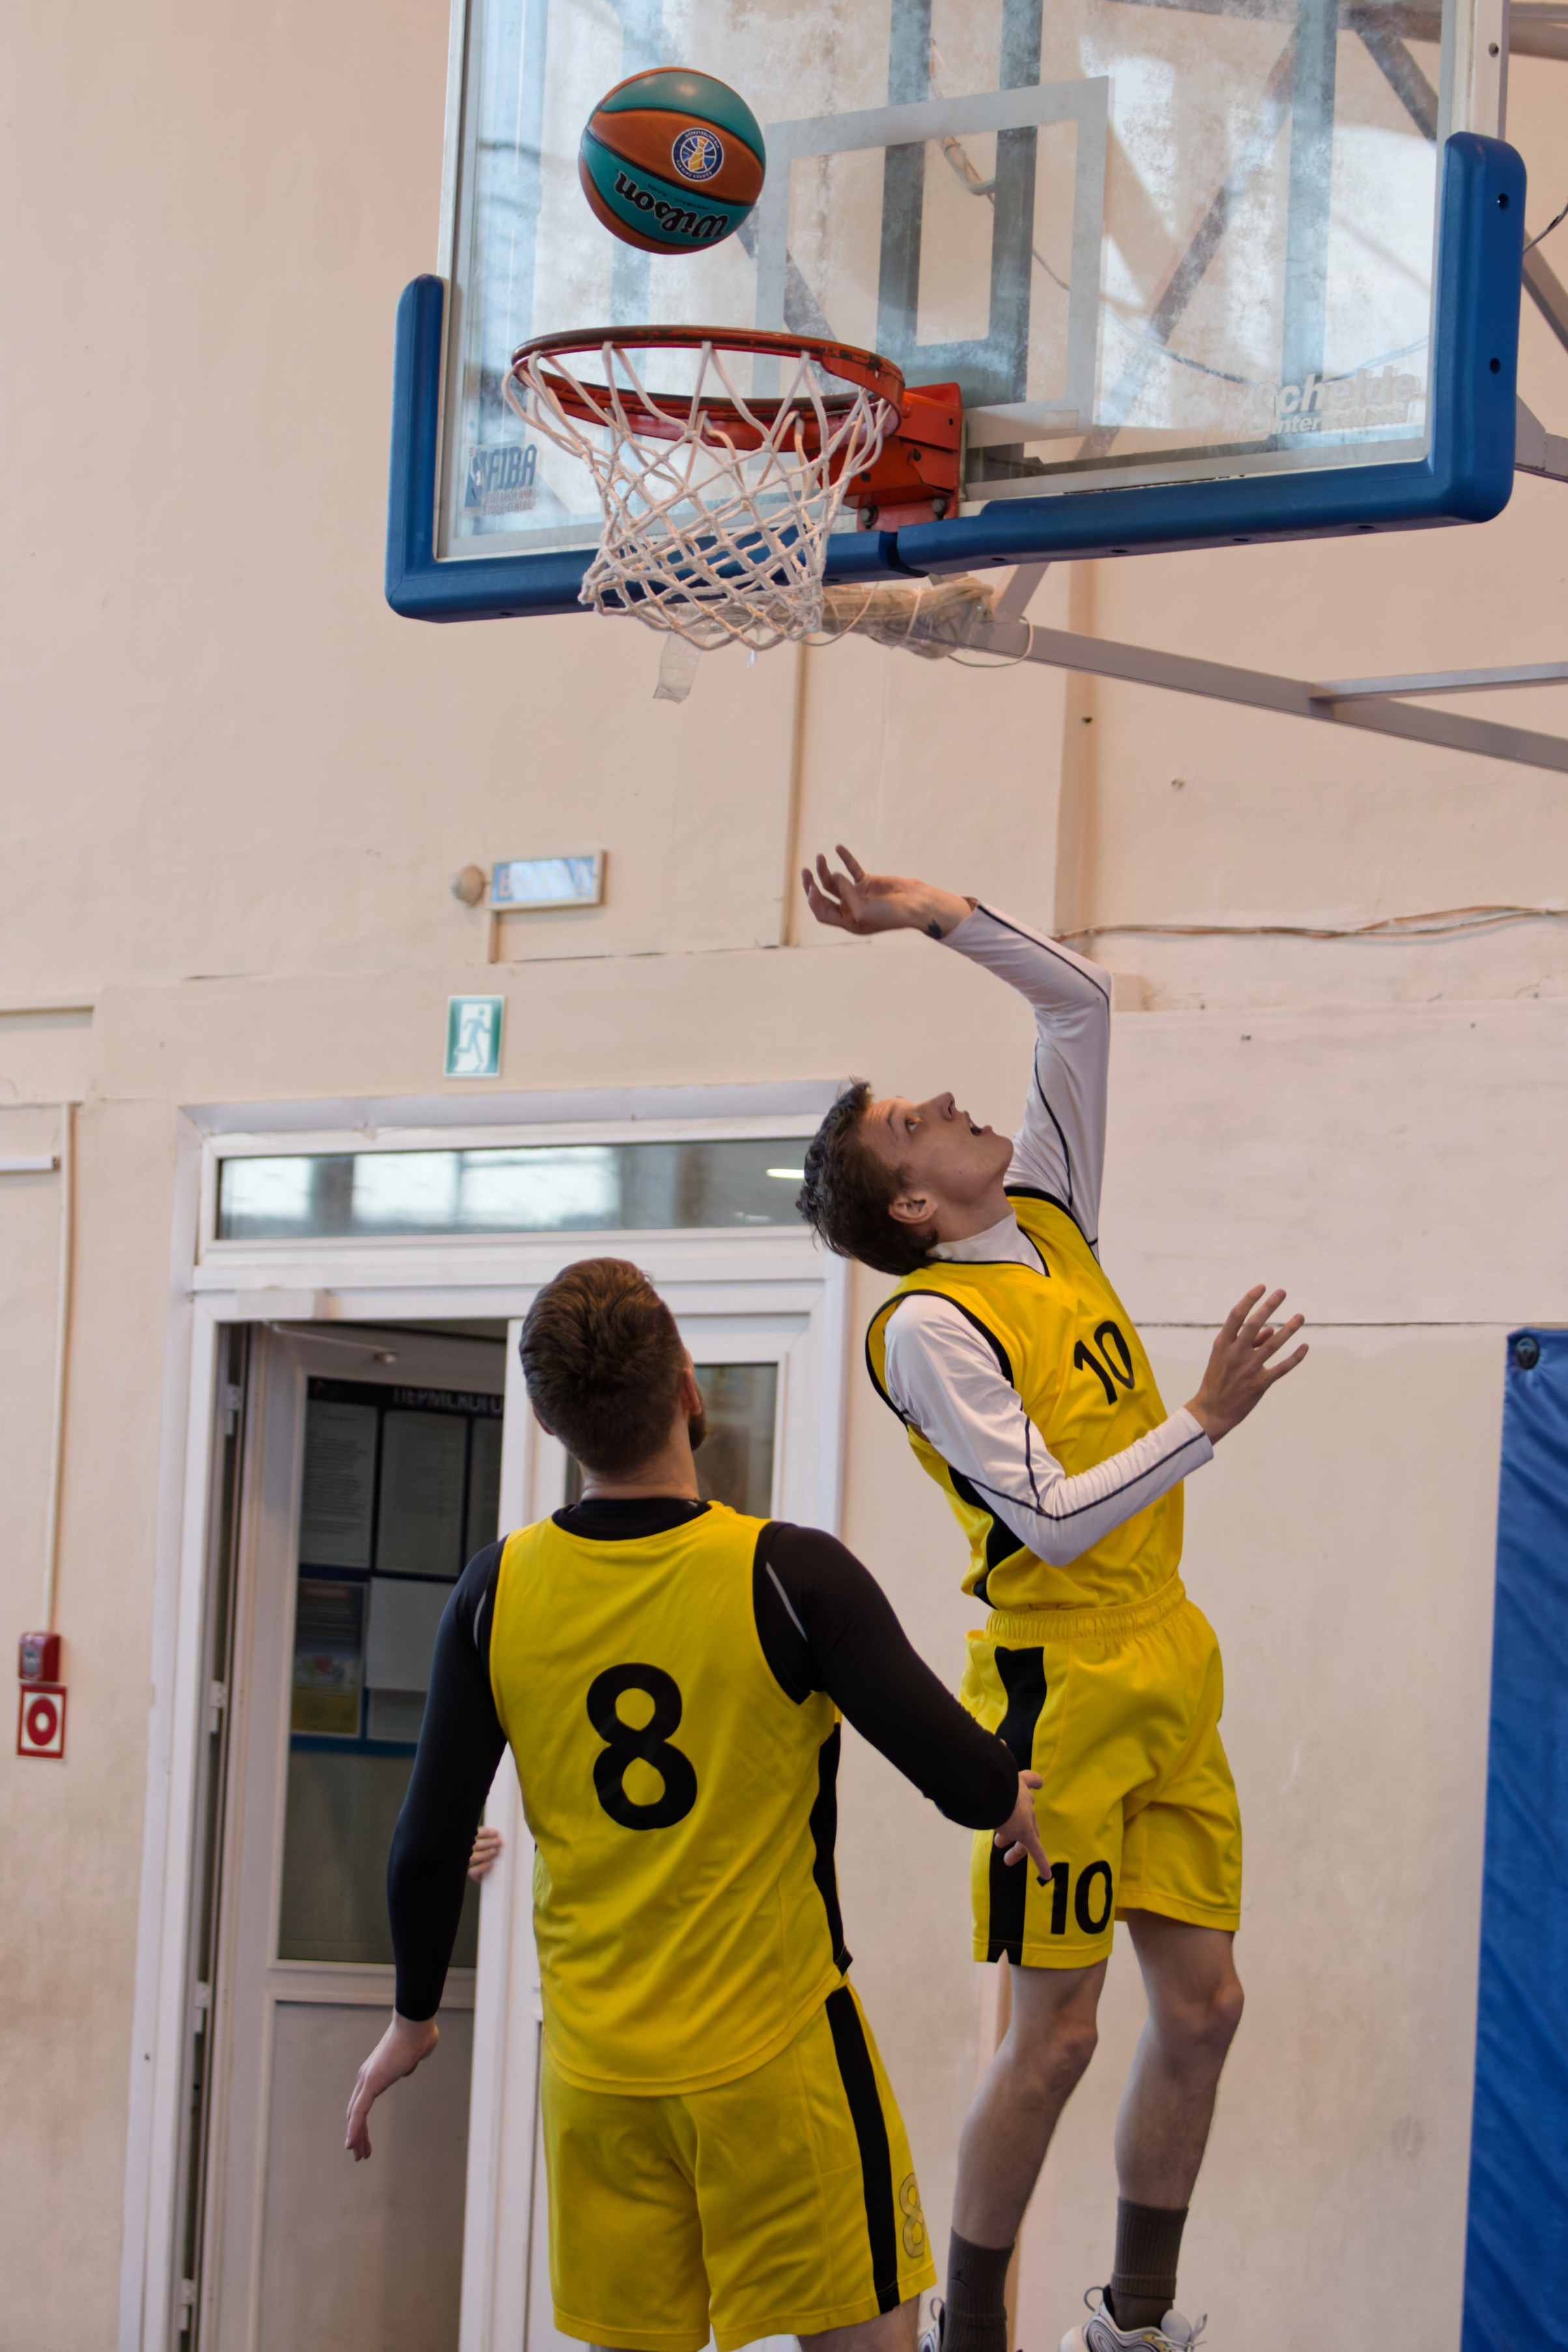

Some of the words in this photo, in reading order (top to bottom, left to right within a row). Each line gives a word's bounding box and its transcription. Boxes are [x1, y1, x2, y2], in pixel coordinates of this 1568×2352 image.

[615, 170, 729, 238] Wilson
[488, 443, 538, 492] FIBA
[1074, 1321, 1135, 1405] 10
[587, 1662, 697, 1830] 8
[1037, 1860, 1112, 1935] 10
[899, 2172, 925, 2258] 8
